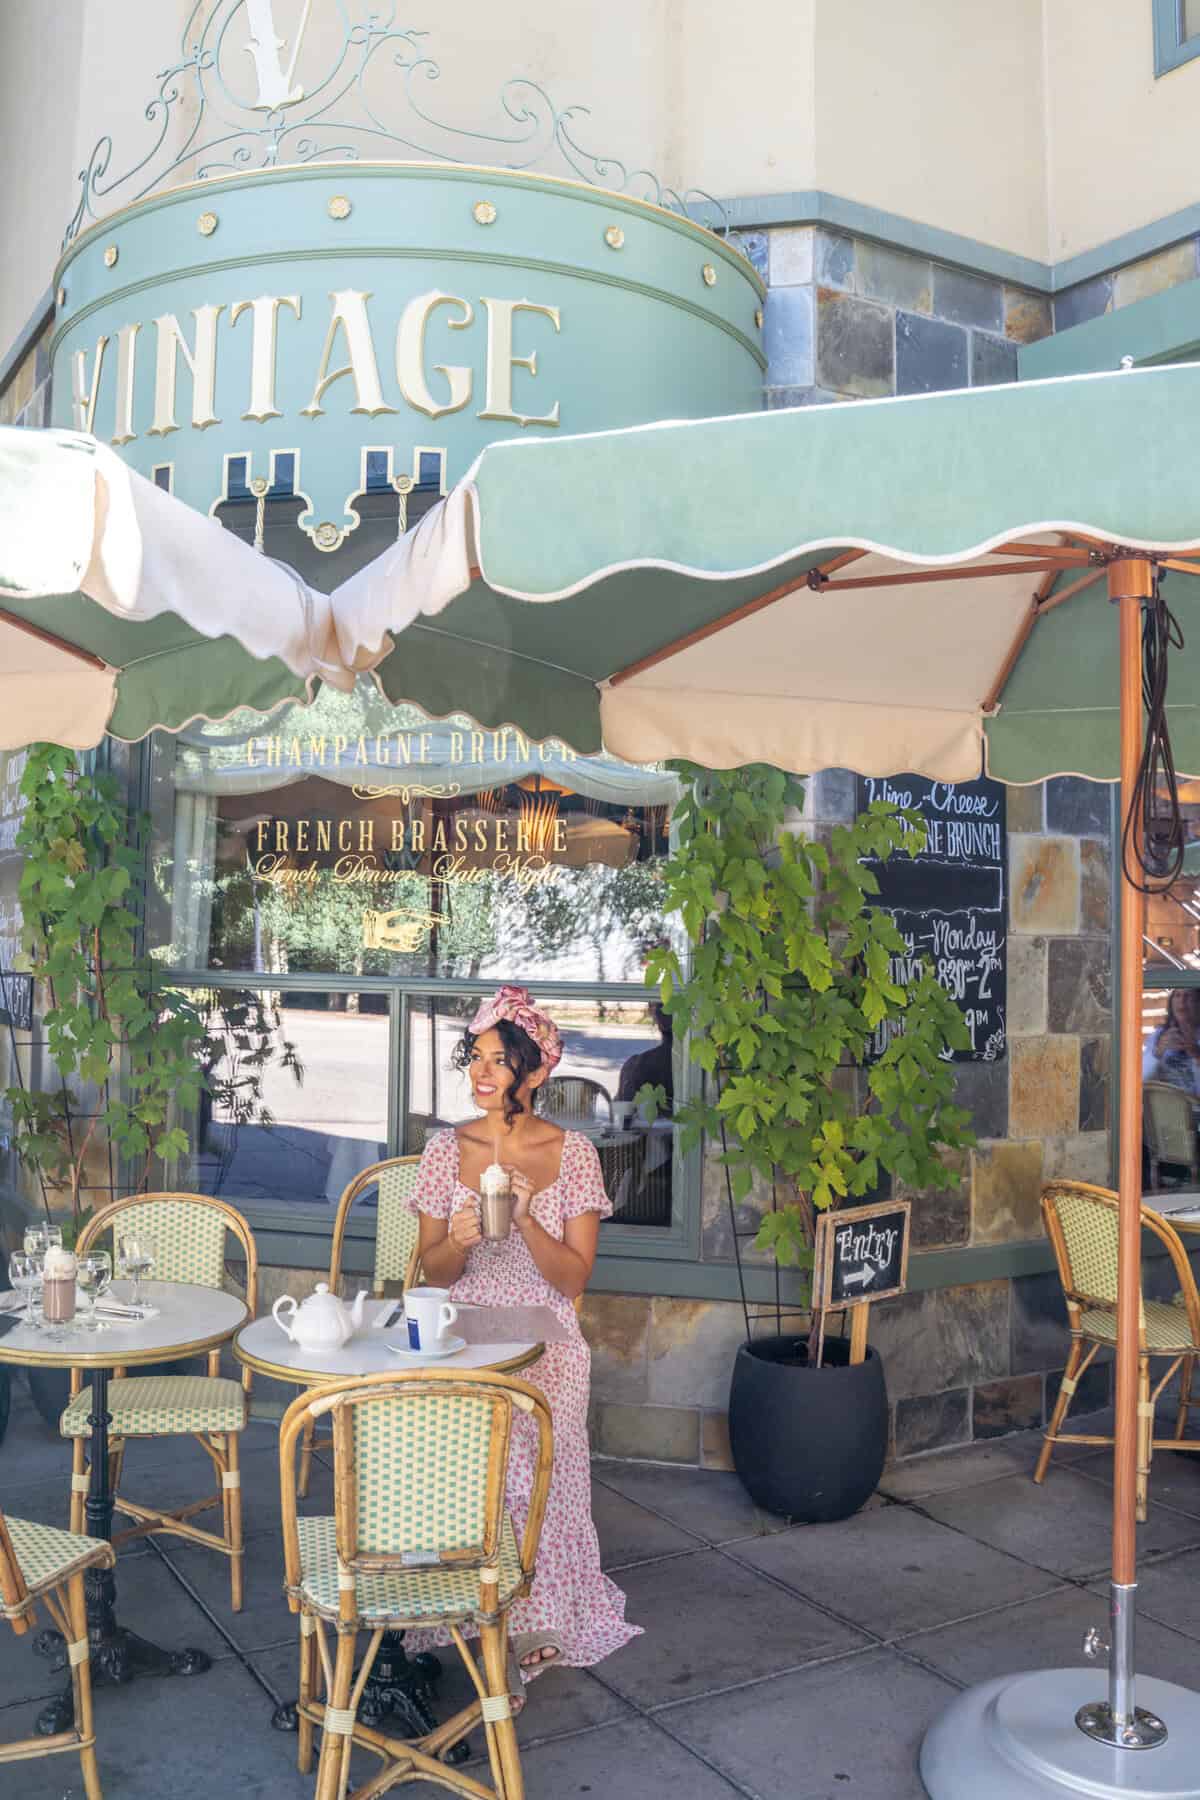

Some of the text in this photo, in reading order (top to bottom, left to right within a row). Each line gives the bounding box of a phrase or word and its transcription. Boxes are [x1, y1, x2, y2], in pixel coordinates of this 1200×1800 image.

[72, 288, 562, 445] VINTAGE
[247, 732, 433, 768] CHAMPAGNE
[256, 818, 568, 853] FRENCH BRASSERIE
[946, 820, 1000, 861] BRUNCH
[429, 854, 485, 885] Late
[493, 853, 561, 896] Night
[836, 1224, 897, 1269] Entry
